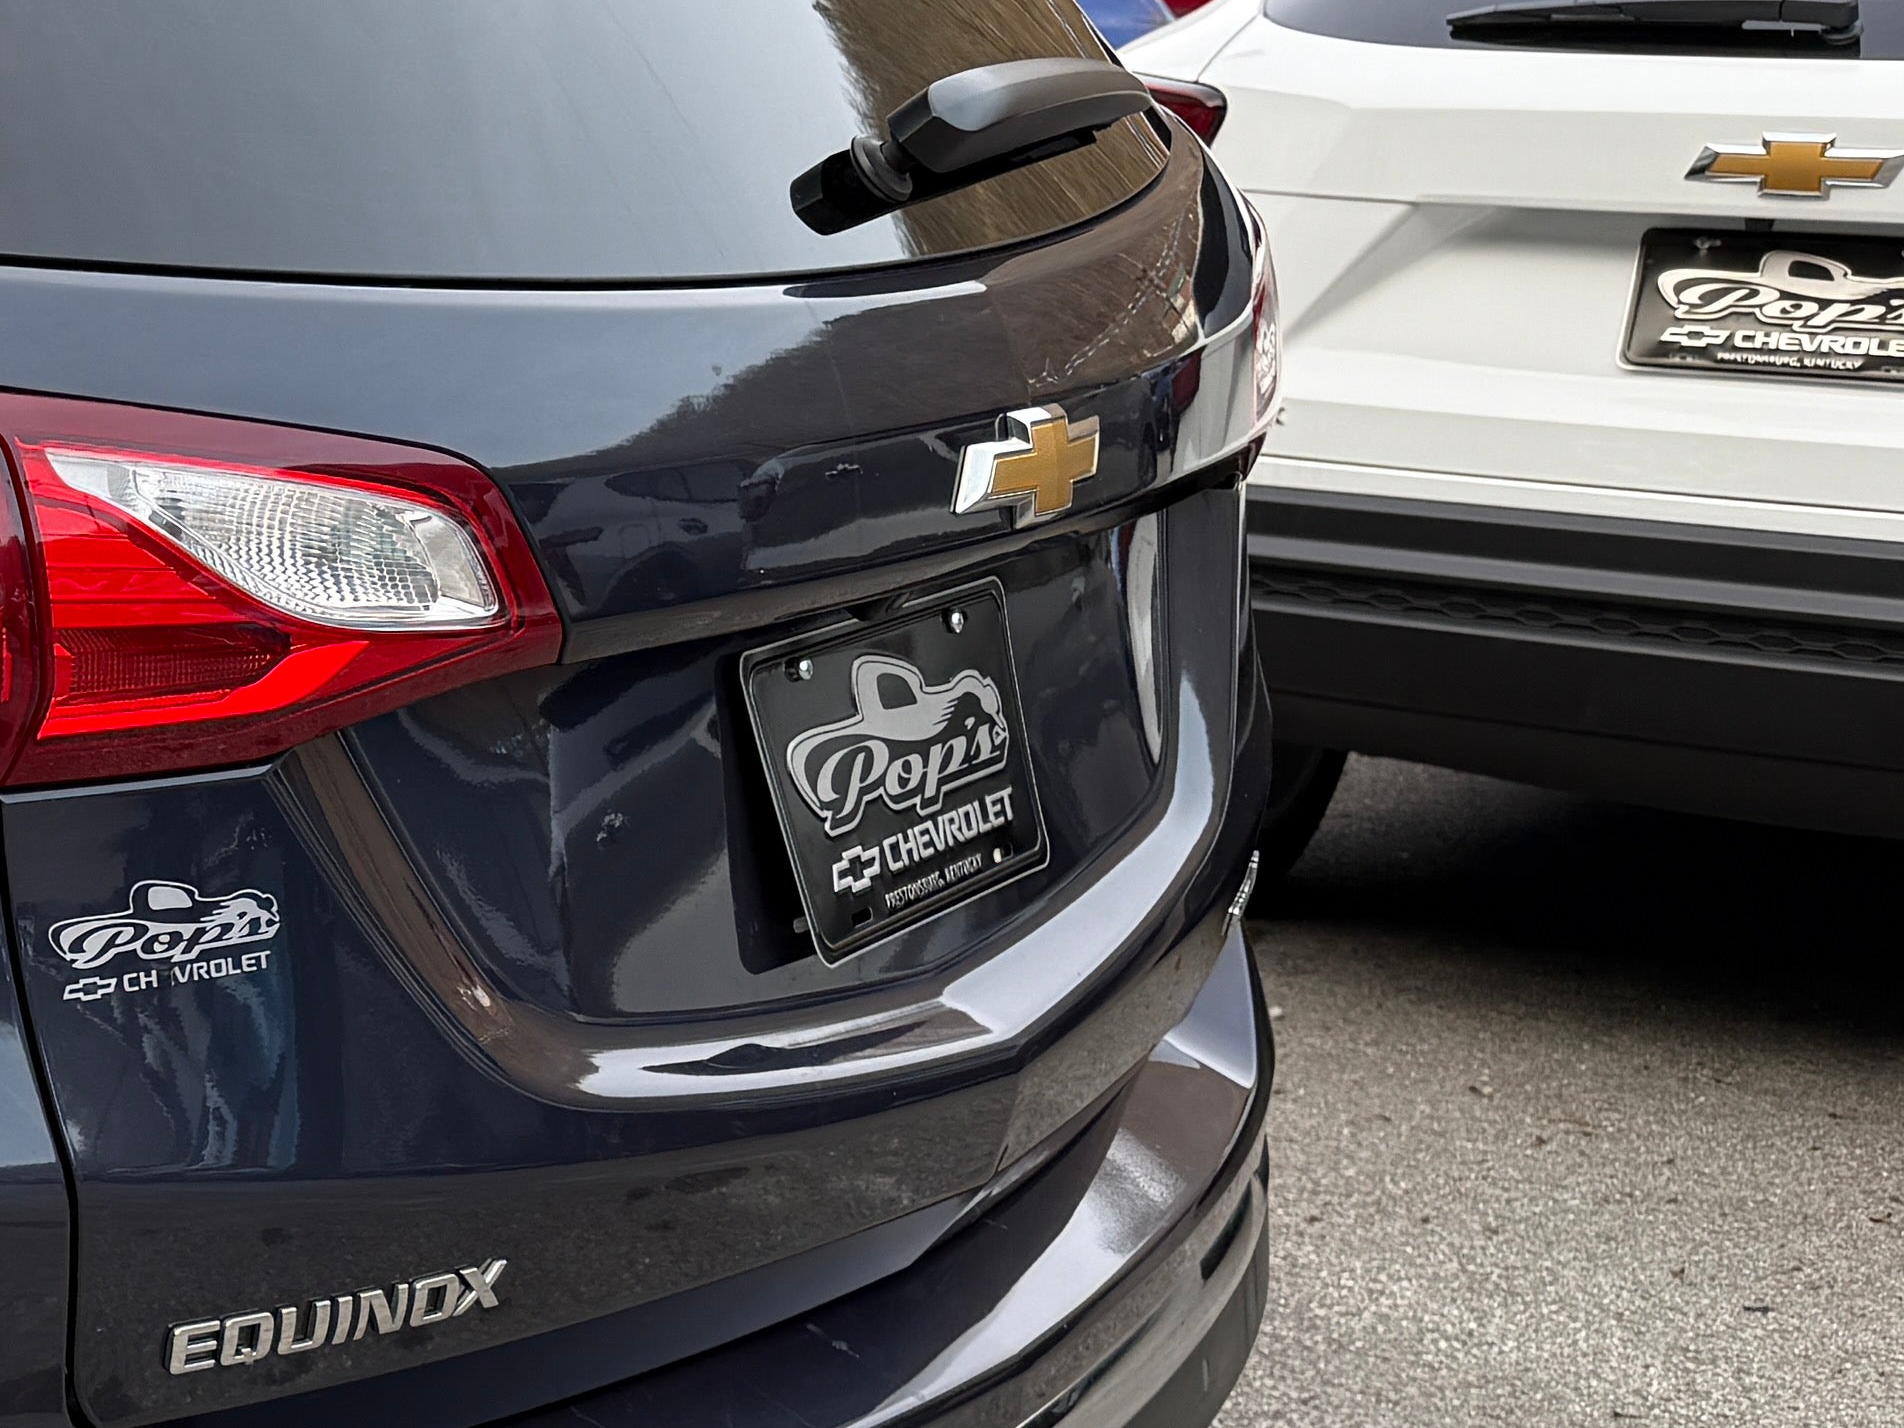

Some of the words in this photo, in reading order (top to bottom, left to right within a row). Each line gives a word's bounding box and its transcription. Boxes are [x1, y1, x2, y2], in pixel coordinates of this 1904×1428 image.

[1733, 329, 1904, 357] CHEVROLE
[816, 716, 1001, 819] Pop's
[884, 785, 1013, 873] CHEVROLET
[122, 950, 272, 993] CHVROLET
[164, 1257, 509, 1376] EQUINOX
